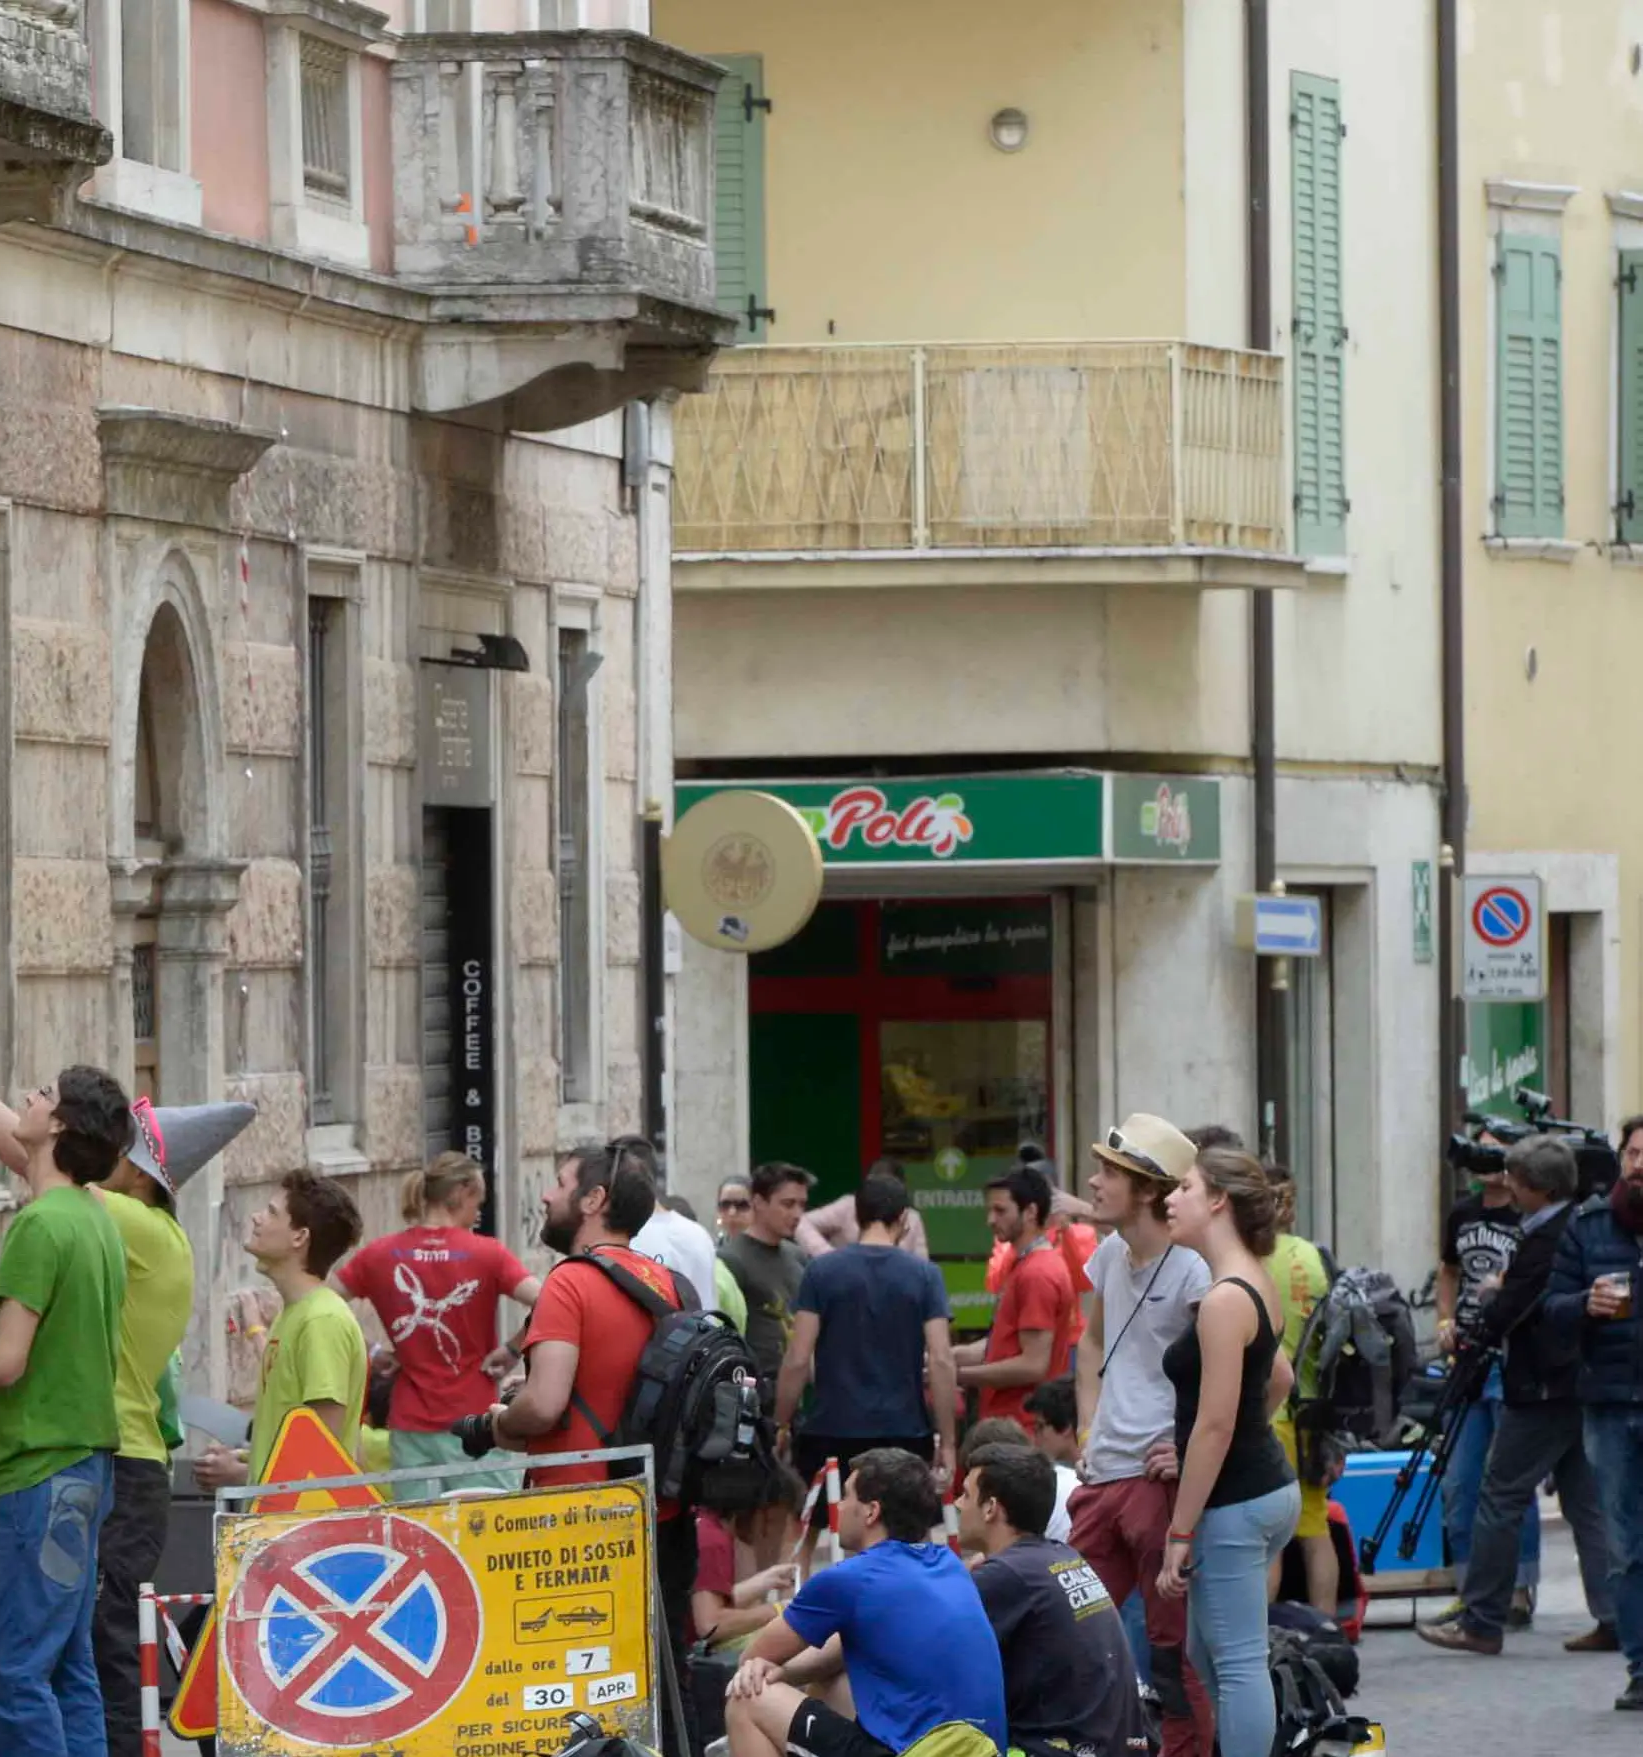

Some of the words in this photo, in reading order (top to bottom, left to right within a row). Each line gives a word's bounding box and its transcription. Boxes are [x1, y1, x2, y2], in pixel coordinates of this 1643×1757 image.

[828, 786, 959, 852] Poli
[463, 959, 482, 1070] COFFEE
[465, 1088, 482, 1107] &
[913, 1189, 985, 1208] ENTRATA
[494, 1513, 558, 1533] Comune
[564, 1506, 578, 1525] di
[487, 1548, 552, 1572] DIVIETO
[560, 1545, 578, 1565] DI
[583, 1539, 636, 1562] SOSTA
[516, 1573, 525, 1591] E
[535, 1564, 611, 1589] FERMATA
[485, 1660, 523, 1676] dalle
[532, 1658, 557, 1671] ore
[580, 1653, 594, 1670] 7
[486, 1692, 509, 1707] del
[534, 1688, 566, 1706] 30
[457, 1722, 493, 1738] PER
[502, 1713, 606, 1734] SICUREA
[455, 1740, 526, 1757] ORDINE
